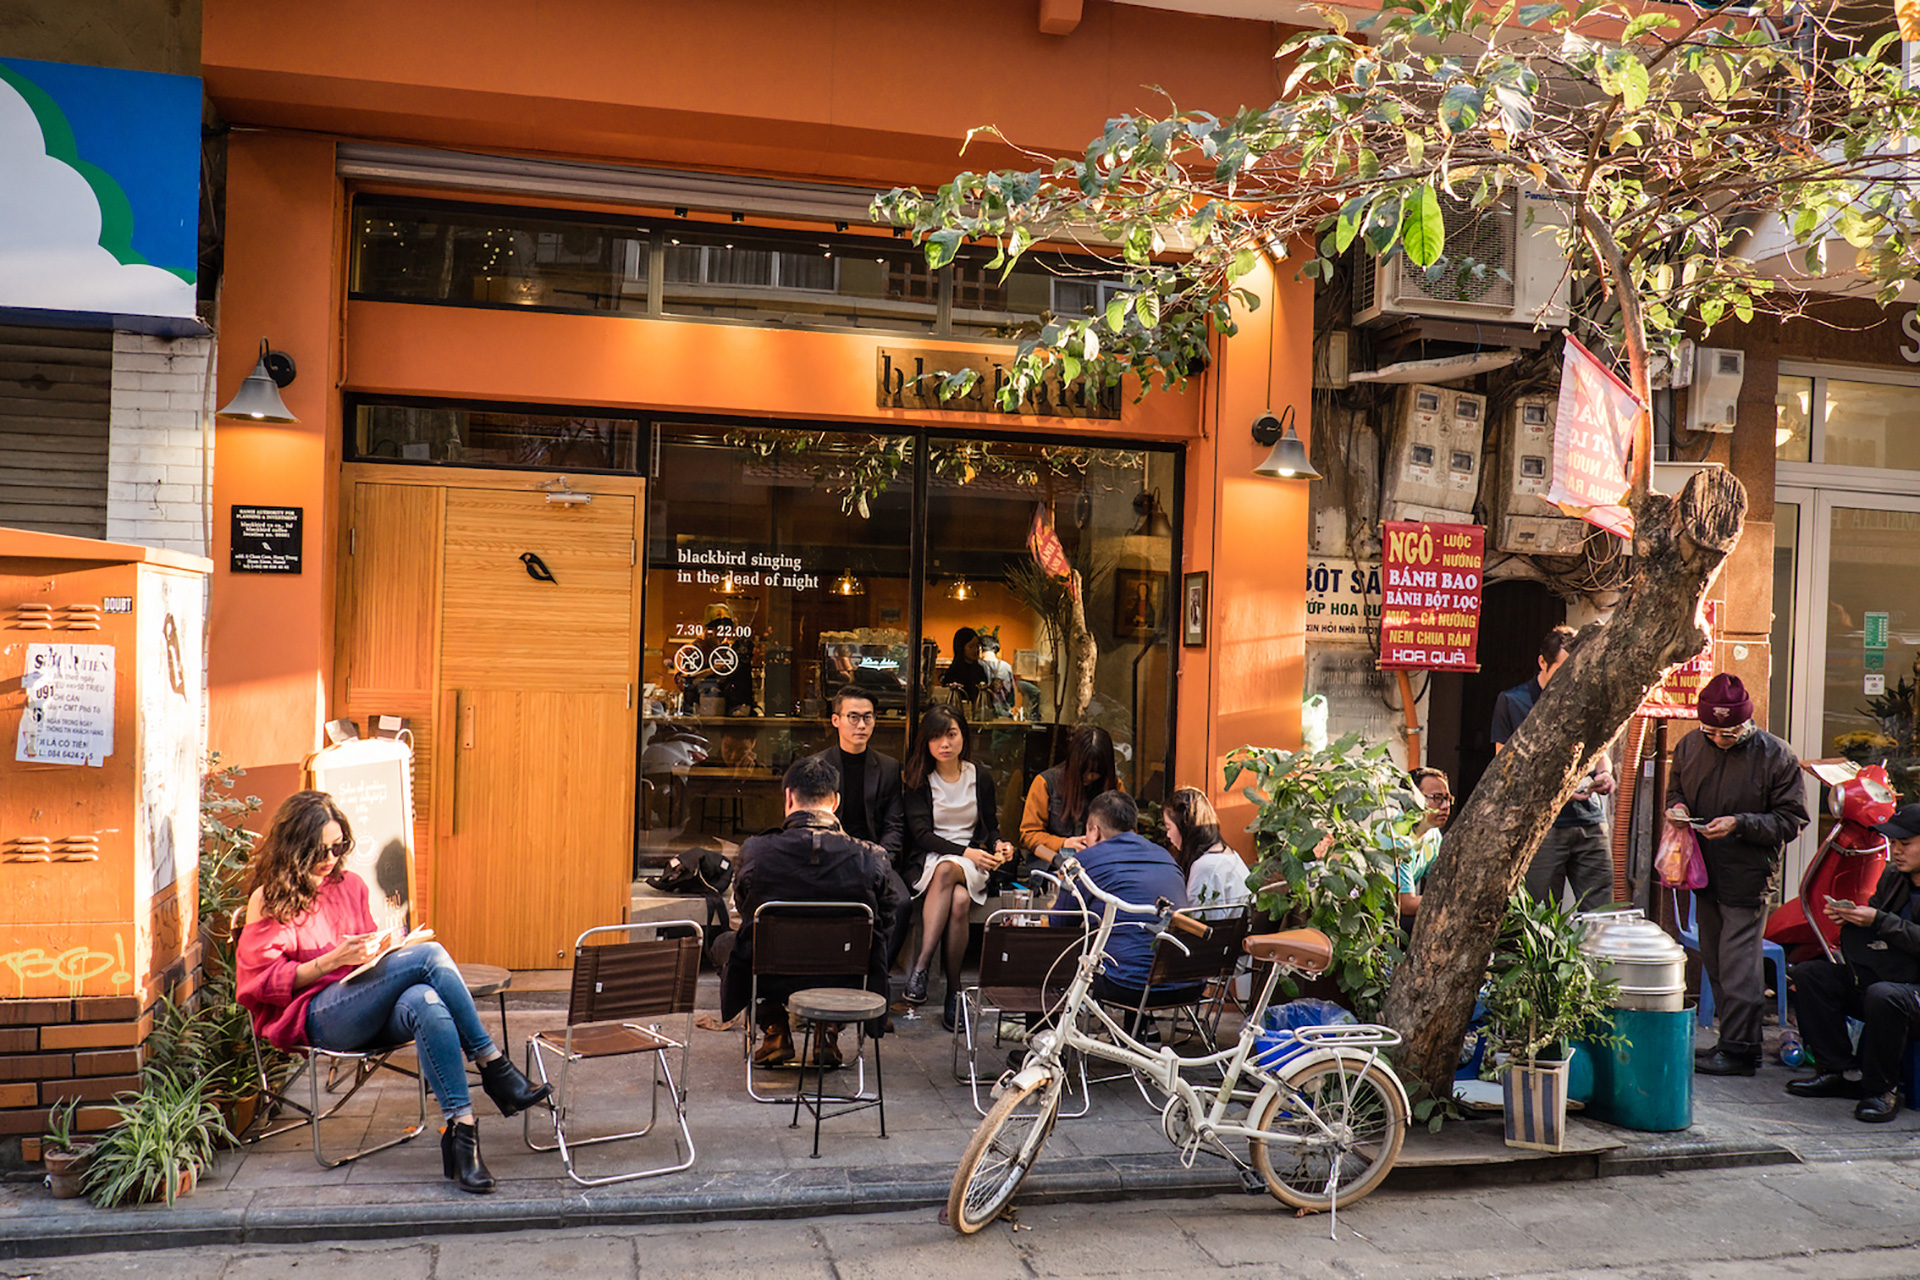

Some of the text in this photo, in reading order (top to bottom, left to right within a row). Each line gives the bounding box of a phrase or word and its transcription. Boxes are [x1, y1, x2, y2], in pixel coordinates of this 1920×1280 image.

[1388, 524, 1434, 566] NGÔ
[1443, 532, 1472, 551] LUỘC
[677, 548, 802, 572] blackbird singing
[1442, 552, 1482, 569] NƯỚNG
[677, 569, 820, 592] in the dead of night
[1388, 565, 1478, 591] BÁNH BAO
[103, 597, 133, 614] DOUBT
[1306, 597, 1326, 615] ỚP
[1330, 602, 1359, 616] HOA
[1386, 588, 1479, 613] BÁNH BỘT LỌC
[1321, 621, 1337, 633] HỎI
[1420, 609, 1436, 626] CÁ
[1437, 611, 1477, 629] NƯỚNG
[676, 623, 704, 637] 7.30
[716, 624, 752, 638] 22.00
[1388, 629, 1472, 647] NEM CHUA RÁN
[1392, 649, 1467, 665] HOA QUẢ
